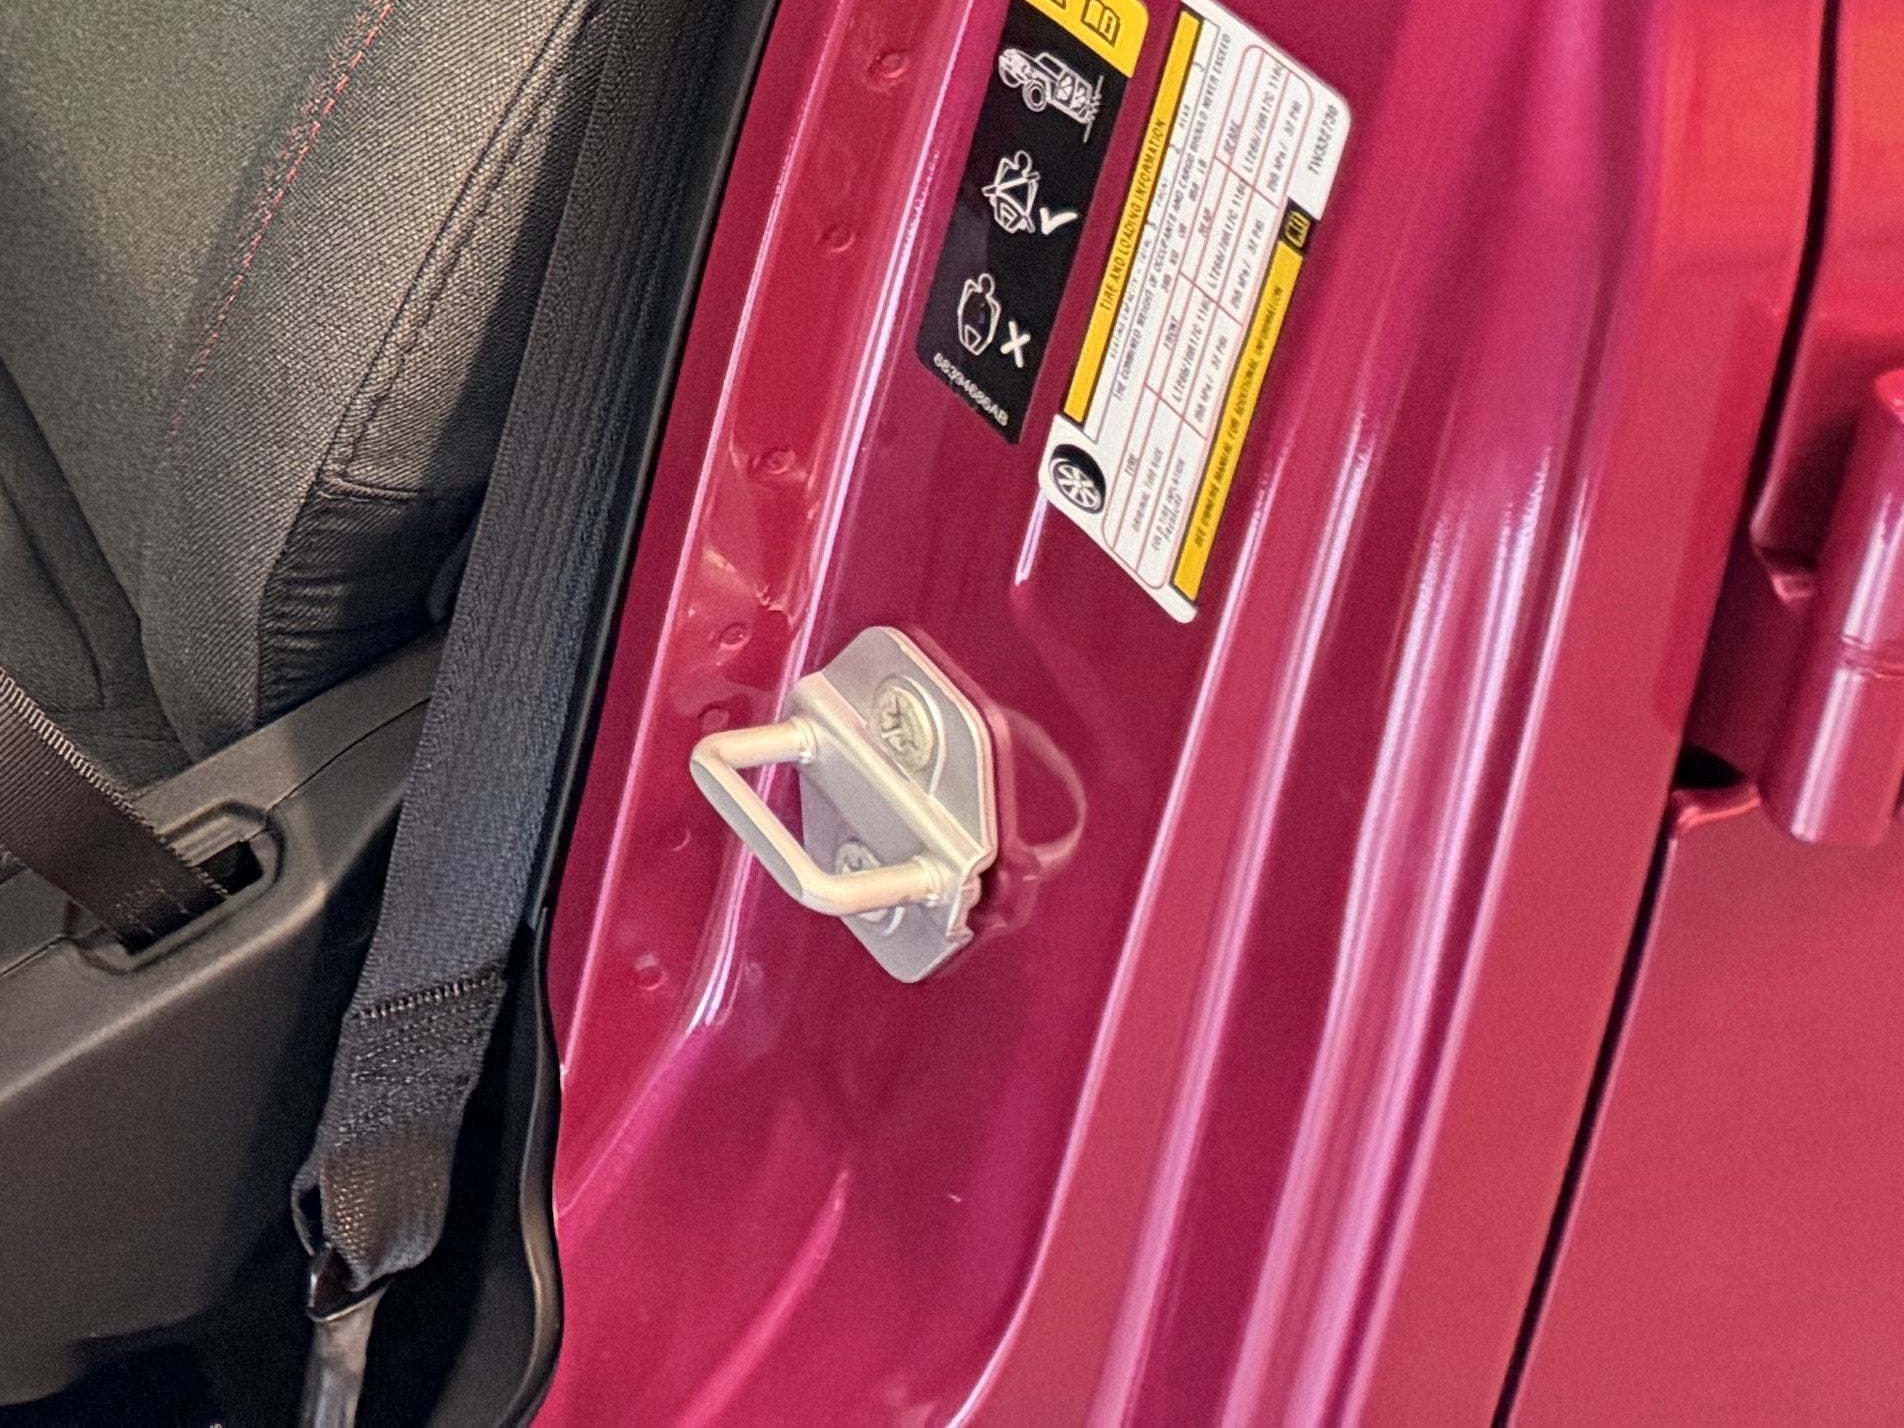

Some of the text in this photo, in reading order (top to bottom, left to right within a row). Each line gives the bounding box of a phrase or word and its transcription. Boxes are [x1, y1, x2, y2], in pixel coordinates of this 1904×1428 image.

[1176, 149, 1196, 190] CARGO
[1100, 114, 1165, 314] TIRE AND LOADING INFORMATION
[1169, 186, 1185, 214] AND
[1152, 210, 1178, 274] OCCUPANTS
